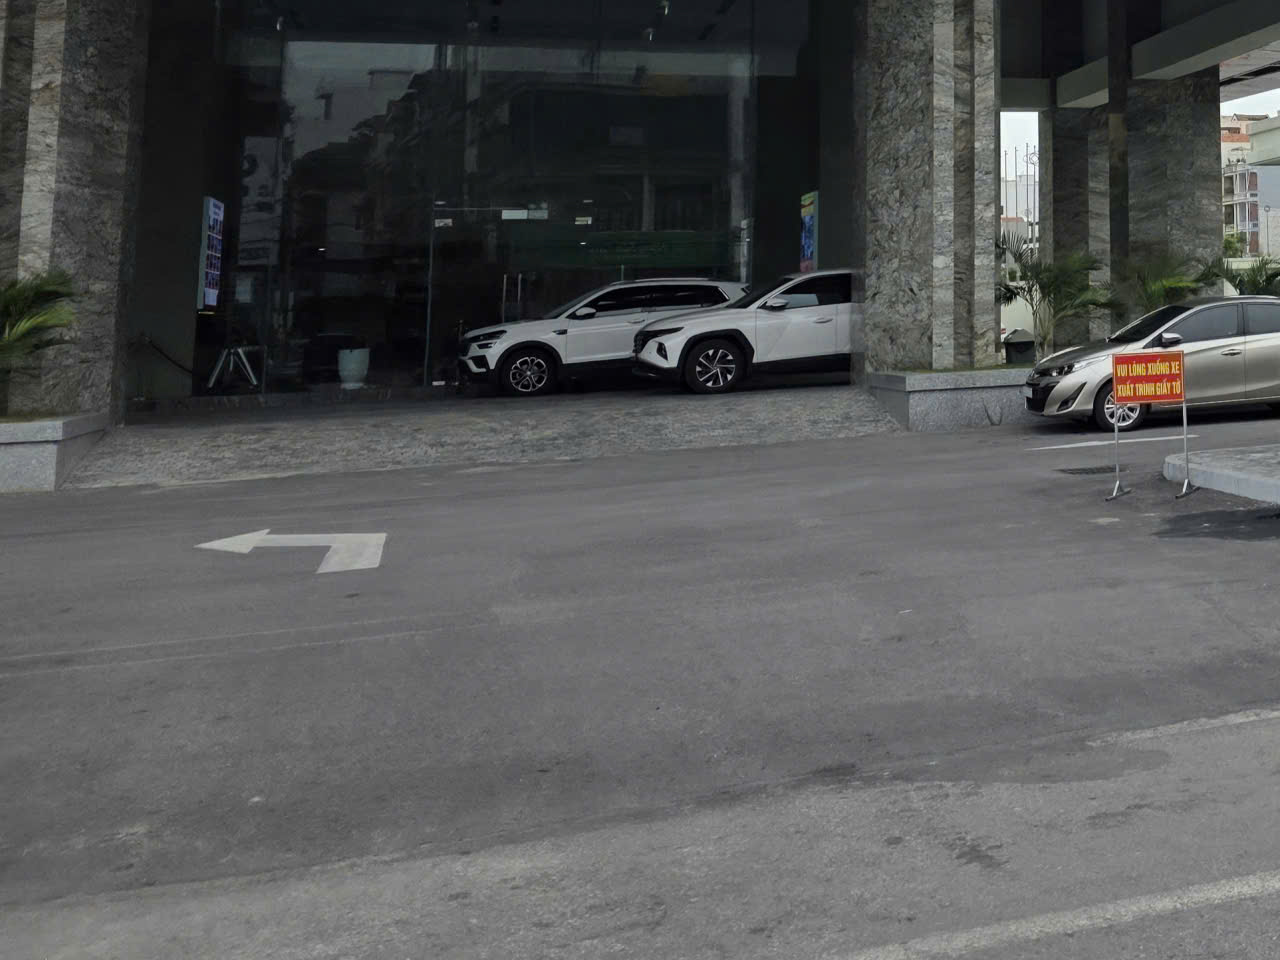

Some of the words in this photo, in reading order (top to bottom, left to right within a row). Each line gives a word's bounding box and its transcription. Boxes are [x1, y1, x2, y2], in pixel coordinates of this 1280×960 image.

[1116, 364, 1128, 377] VUI
[1129, 361, 1146, 376] LÒNG
[1147, 358, 1170, 376] XUỐNG
[1171, 361, 1180, 374] XE
[1117, 380, 1134, 397] XUẤT
[1135, 381, 1155, 396] TRÌNH
[1156, 378, 1171, 395] GIẤY
[1172, 378, 1181, 395] TỜ
